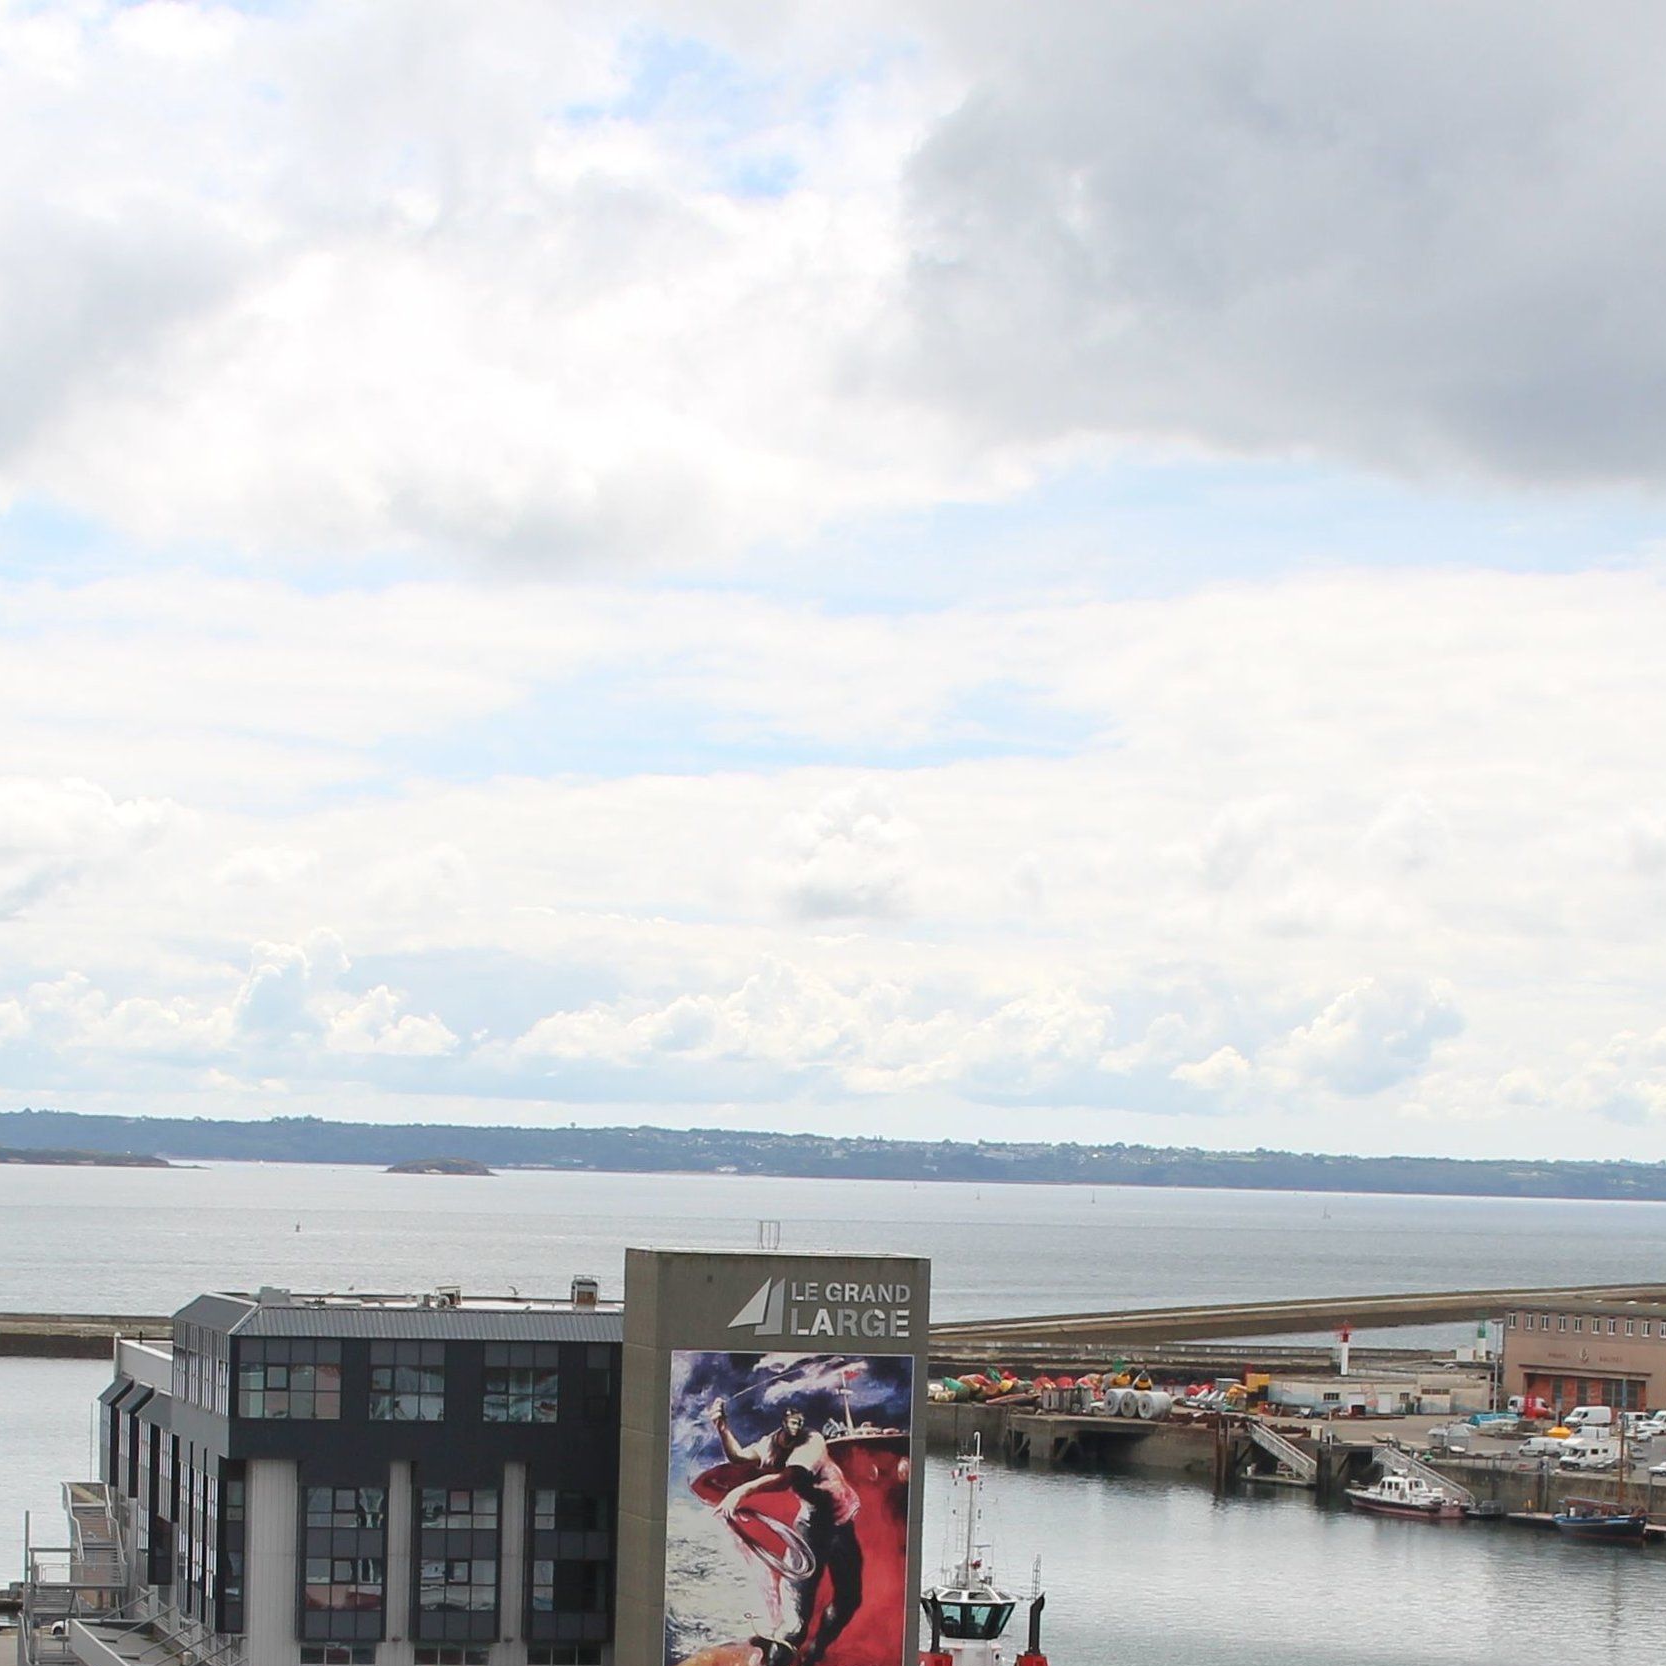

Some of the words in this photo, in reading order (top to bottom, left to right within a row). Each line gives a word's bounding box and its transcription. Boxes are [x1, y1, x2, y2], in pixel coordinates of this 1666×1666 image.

[791, 1282, 818, 1301] LE
[825, 1283, 911, 1303] GRAND
[790, 1308, 910, 1337] LARGE
